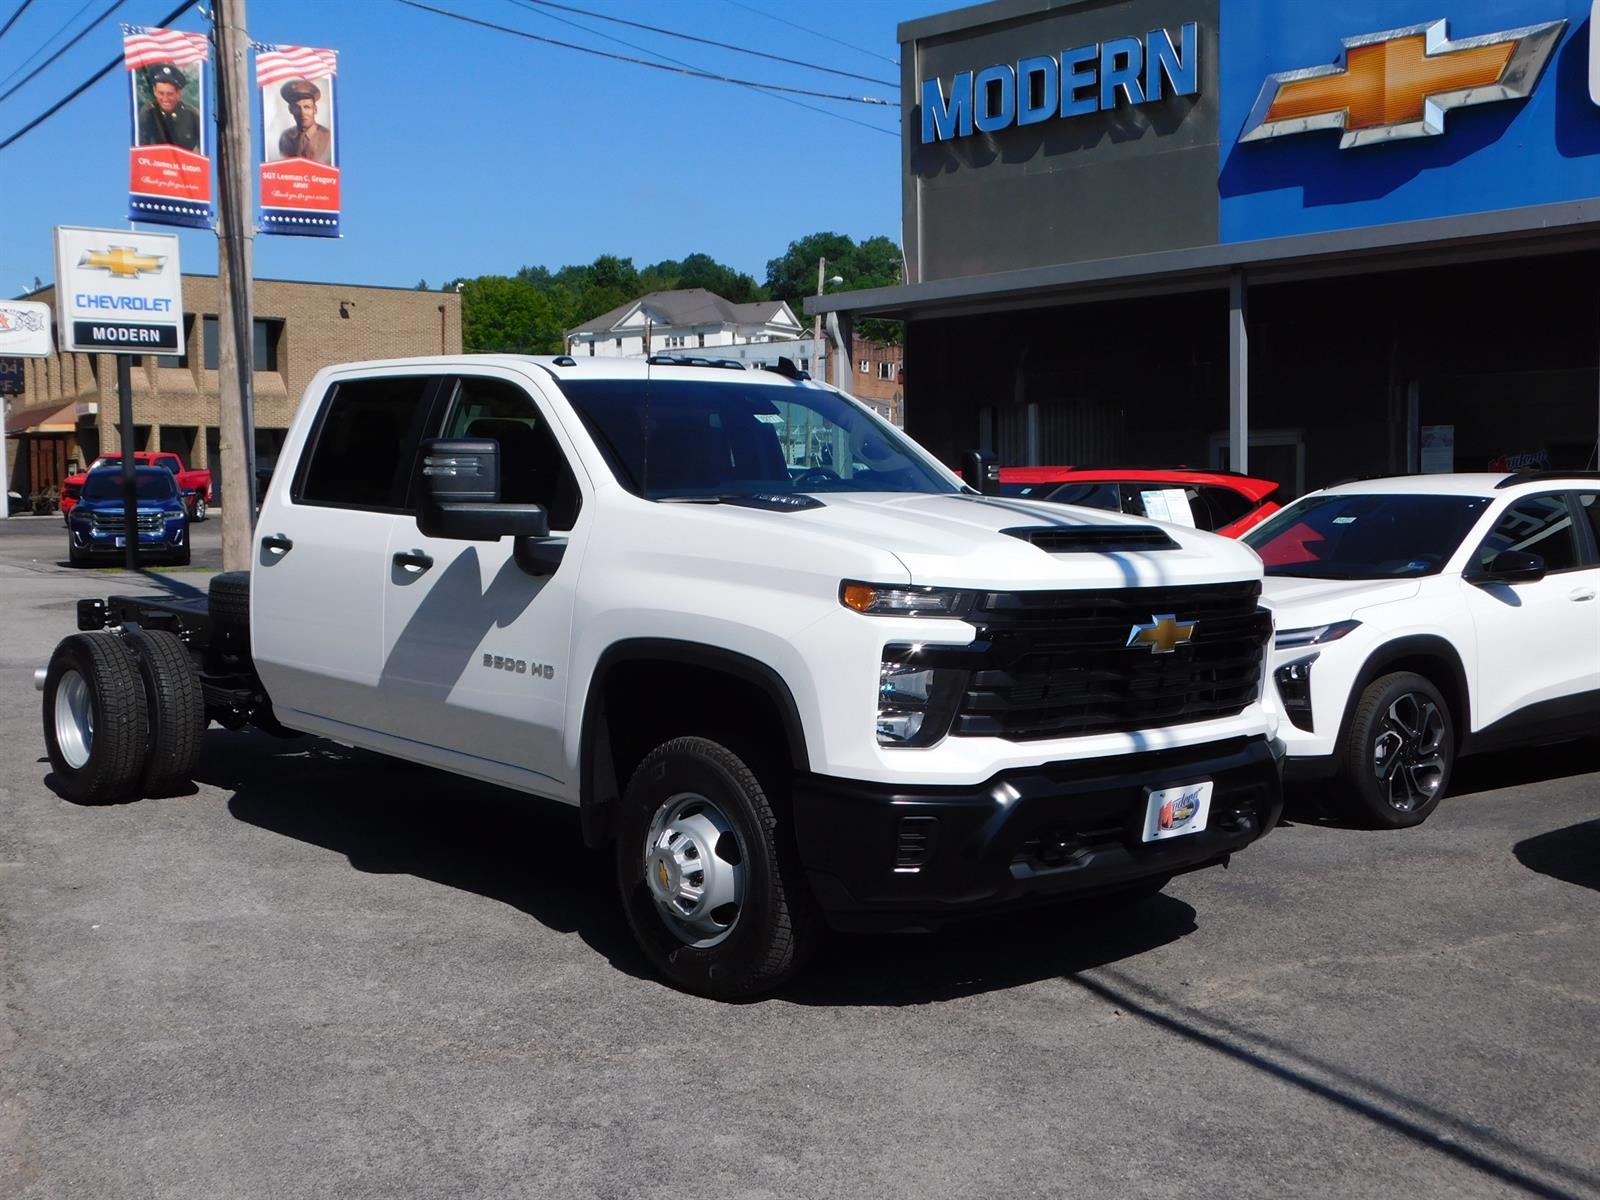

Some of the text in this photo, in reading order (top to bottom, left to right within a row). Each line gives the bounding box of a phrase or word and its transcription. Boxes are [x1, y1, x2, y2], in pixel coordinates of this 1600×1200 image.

[921, 22, 1199, 145] MODERN
[262, 172, 276, 180] SGT
[311, 175, 337, 185] Gregory
[75, 294, 172, 312] CHEVROLET
[92, 327, 161, 342] MODERN
[483, 653, 554, 680] 3500 HD
